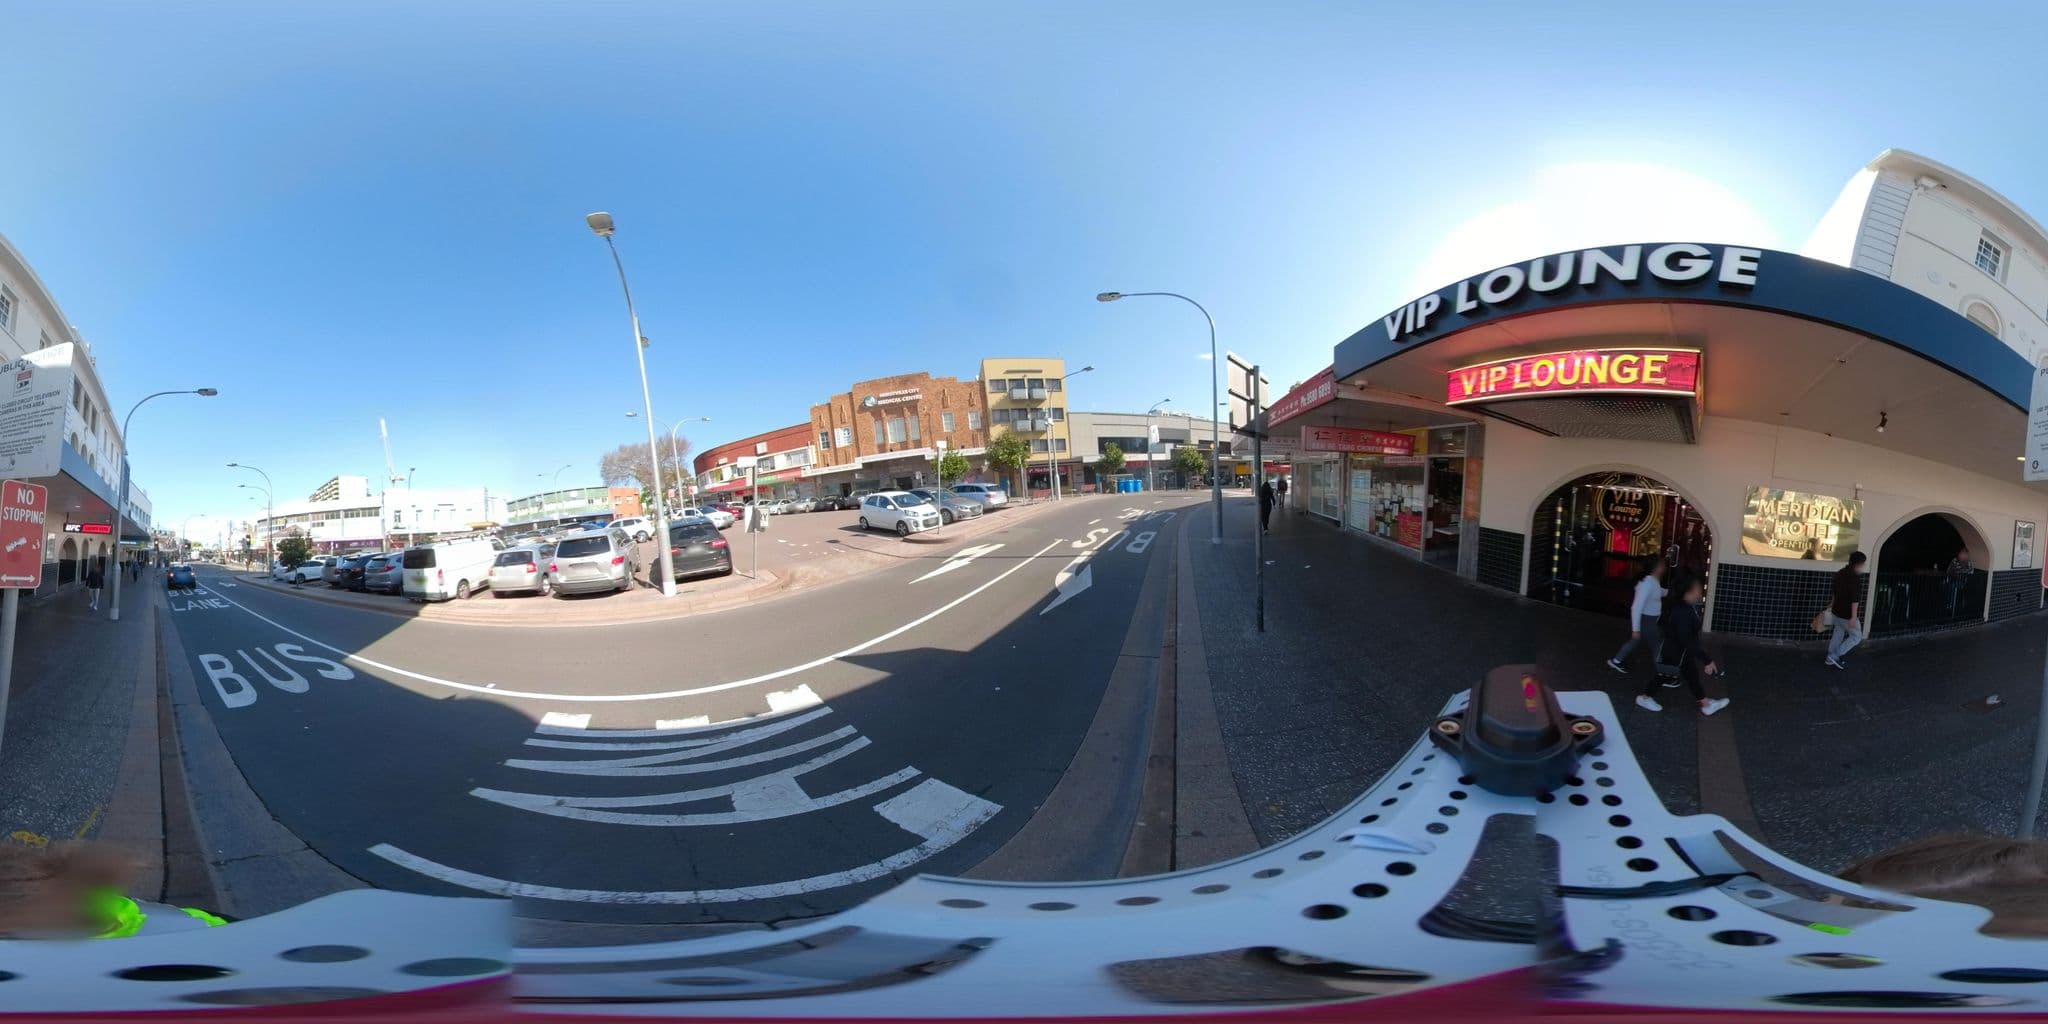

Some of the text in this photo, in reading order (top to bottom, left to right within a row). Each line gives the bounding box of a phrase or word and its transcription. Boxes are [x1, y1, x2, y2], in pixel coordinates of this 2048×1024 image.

[1384, 243, 1763, 342] VIP LOUNGE
[1461, 354, 1669, 396] VIP LOUNGE
[17, 488, 35, 506] NO
[1613, 489, 1643, 505] VIP
[3, 506, 44, 525] STOPPING
[1610, 503, 1642, 517] Lounge
[1758, 498, 1854, 523] MERIDIAN
[1774, 518, 1839, 539] HOTEL
[1071, 527, 1157, 554] BUS
[1769, 537, 1795, 549] OPEN
[168, 587, 208, 598] BUS
[170, 598, 230, 612] LANE
[198, 643, 354, 709] BUS
